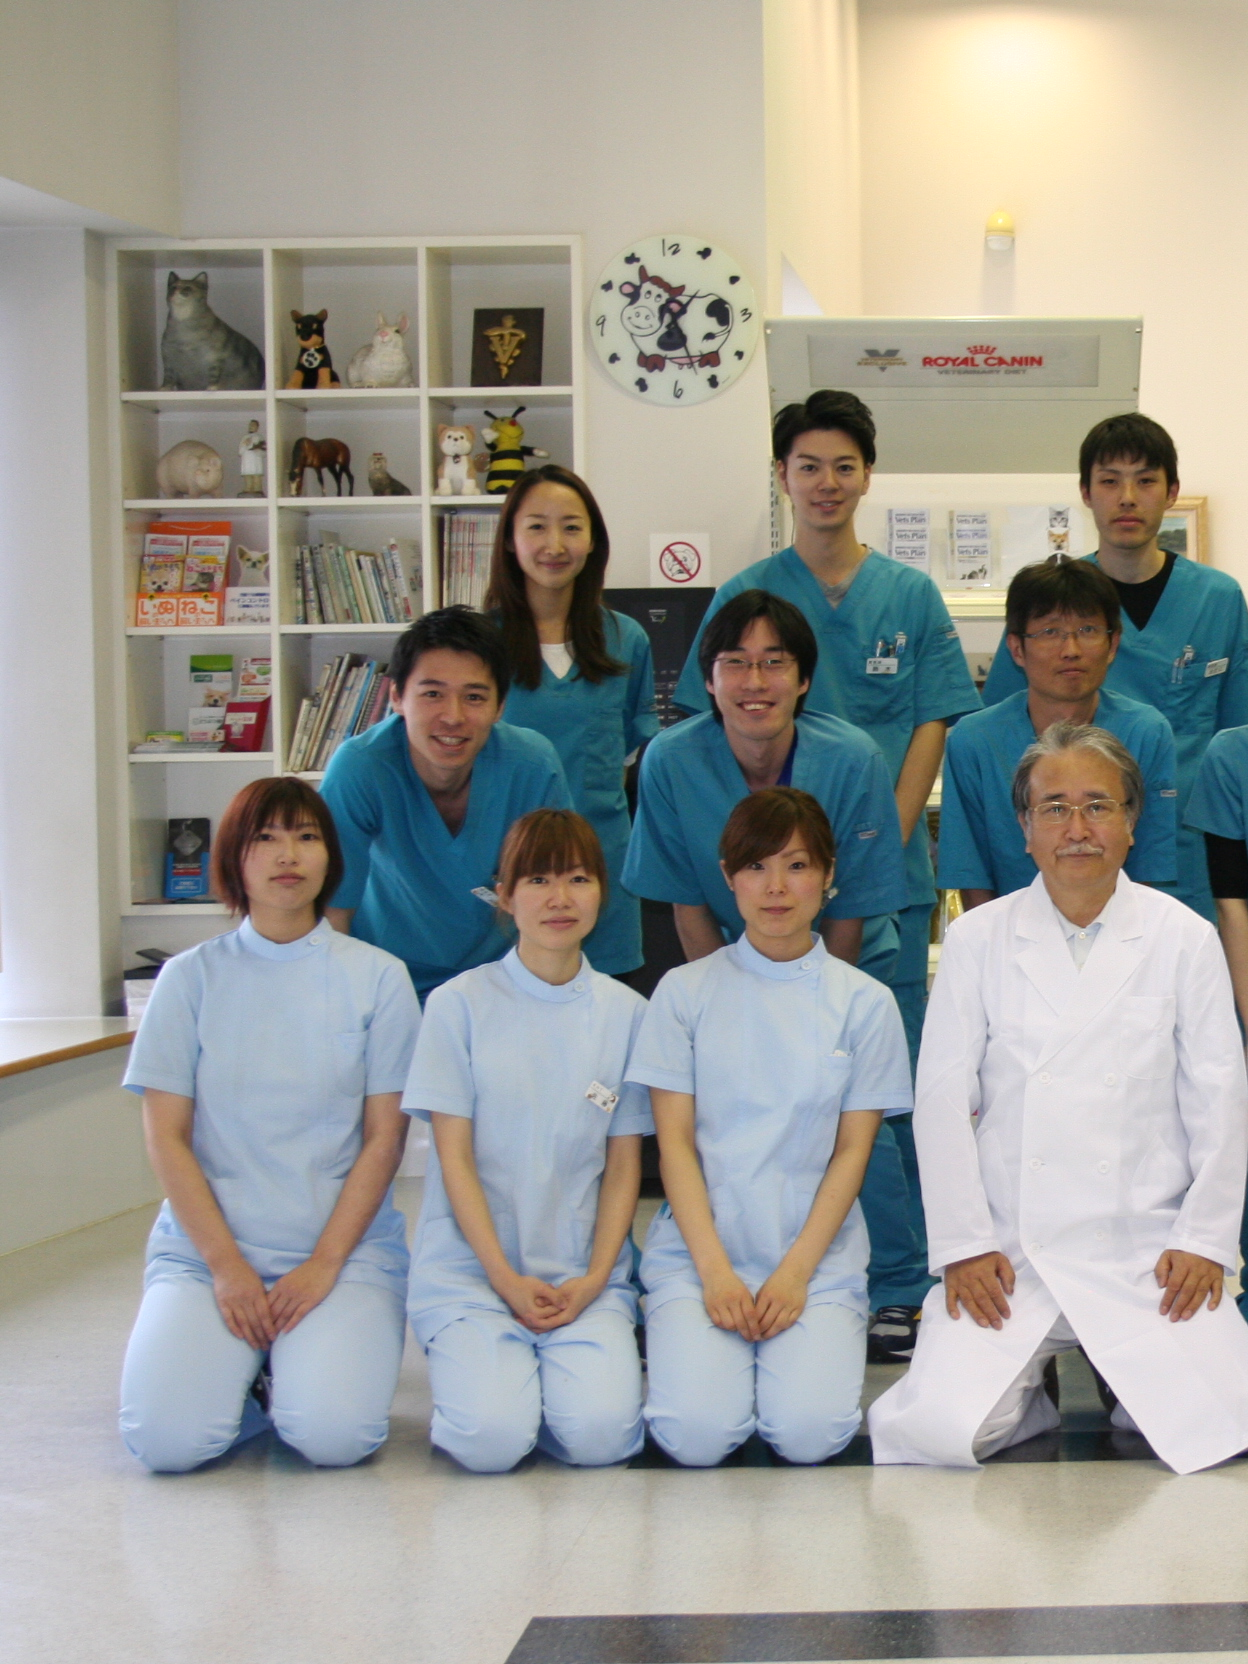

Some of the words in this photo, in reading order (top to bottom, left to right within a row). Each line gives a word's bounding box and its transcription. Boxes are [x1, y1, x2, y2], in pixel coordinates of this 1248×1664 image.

[661, 238, 681, 257] 12
[740, 307, 752, 323] 3
[595, 314, 606, 337] 9
[921, 355, 979, 368] ROYAL
[983, 355, 1043, 368] CANIN
[672, 380, 684, 399] 6
[140, 600, 175, 615] いぬ
[180, 600, 216, 615] ねこ
